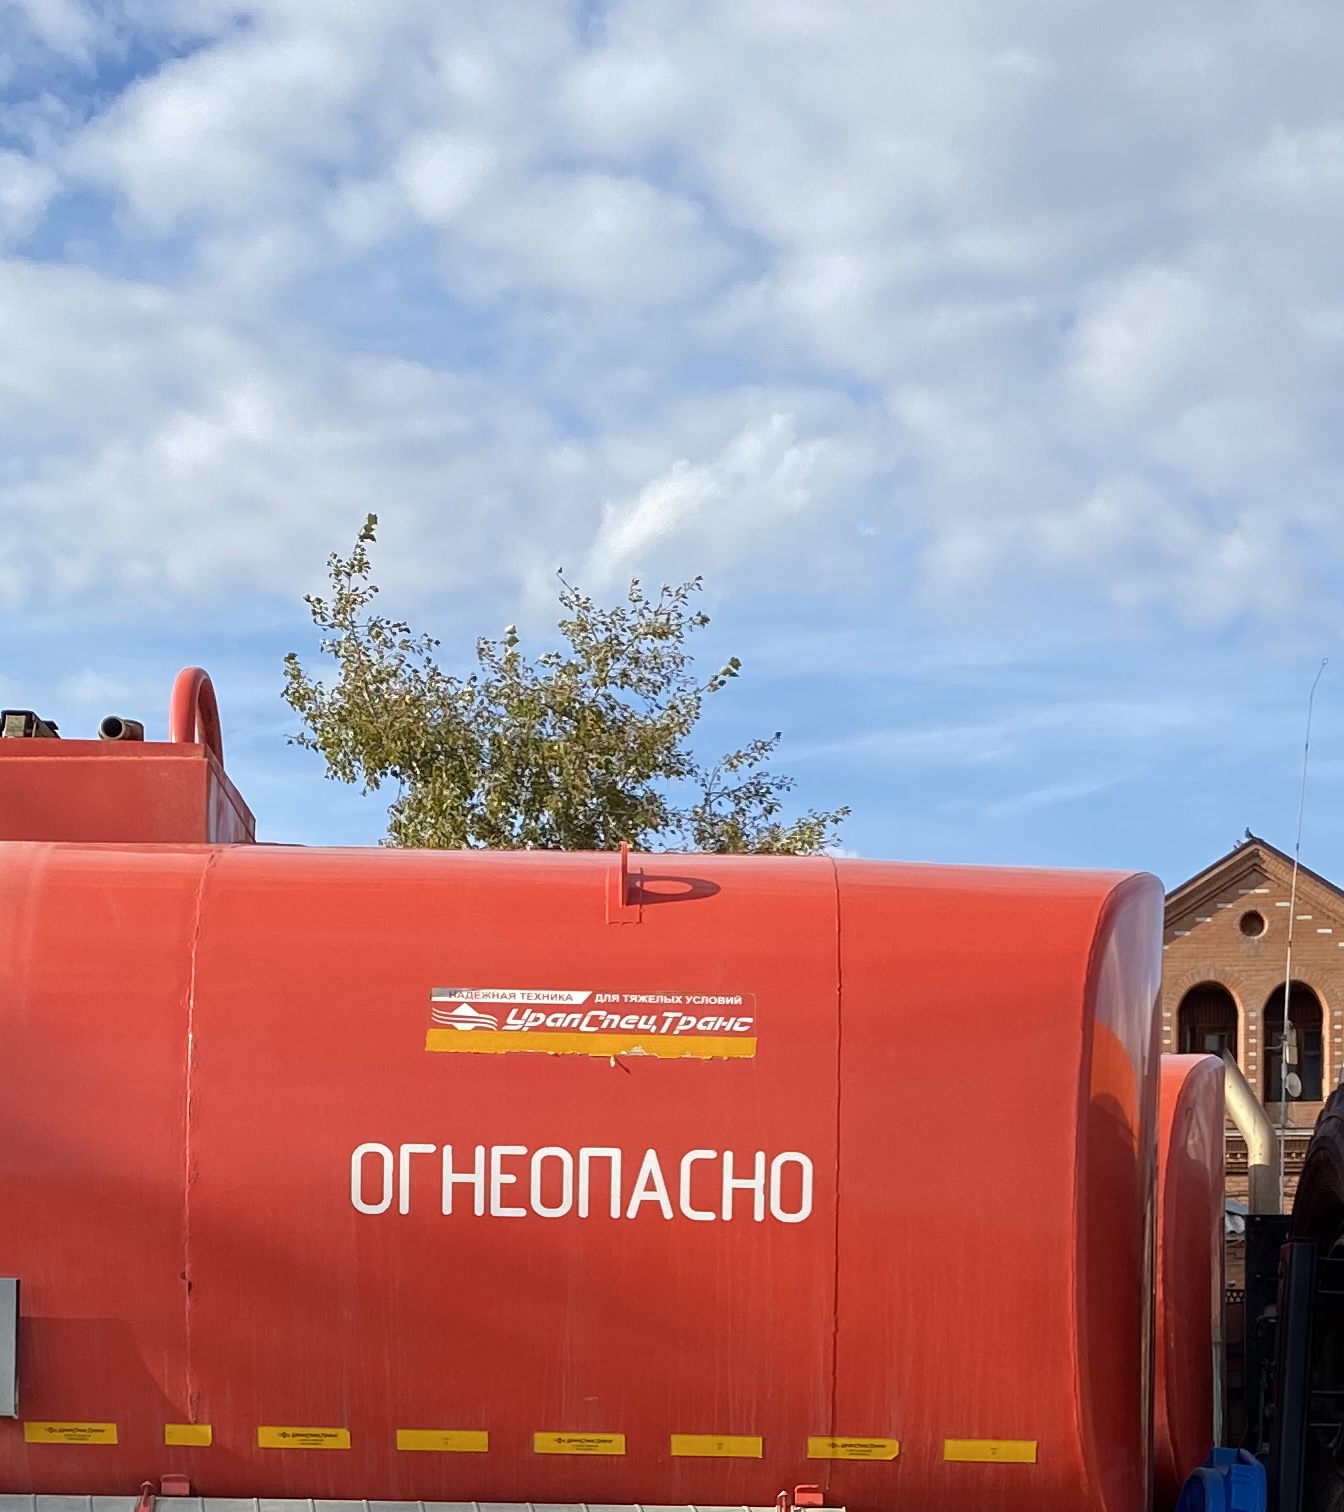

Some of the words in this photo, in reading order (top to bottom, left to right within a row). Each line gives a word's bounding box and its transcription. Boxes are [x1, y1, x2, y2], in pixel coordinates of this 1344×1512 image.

[519, 991, 574, 1002] ТЕХНИКА
[594, 993, 620, 1004] ДЛЯ
[622, 994, 683, 1005] ТЯЖЕЛЫХ
[685, 995, 743, 1006] УСЛОВИЙ
[501, 1008, 754, 1035] УралСпецТранс
[350, 1142, 814, 1224] ОГНЕОПАСНО
